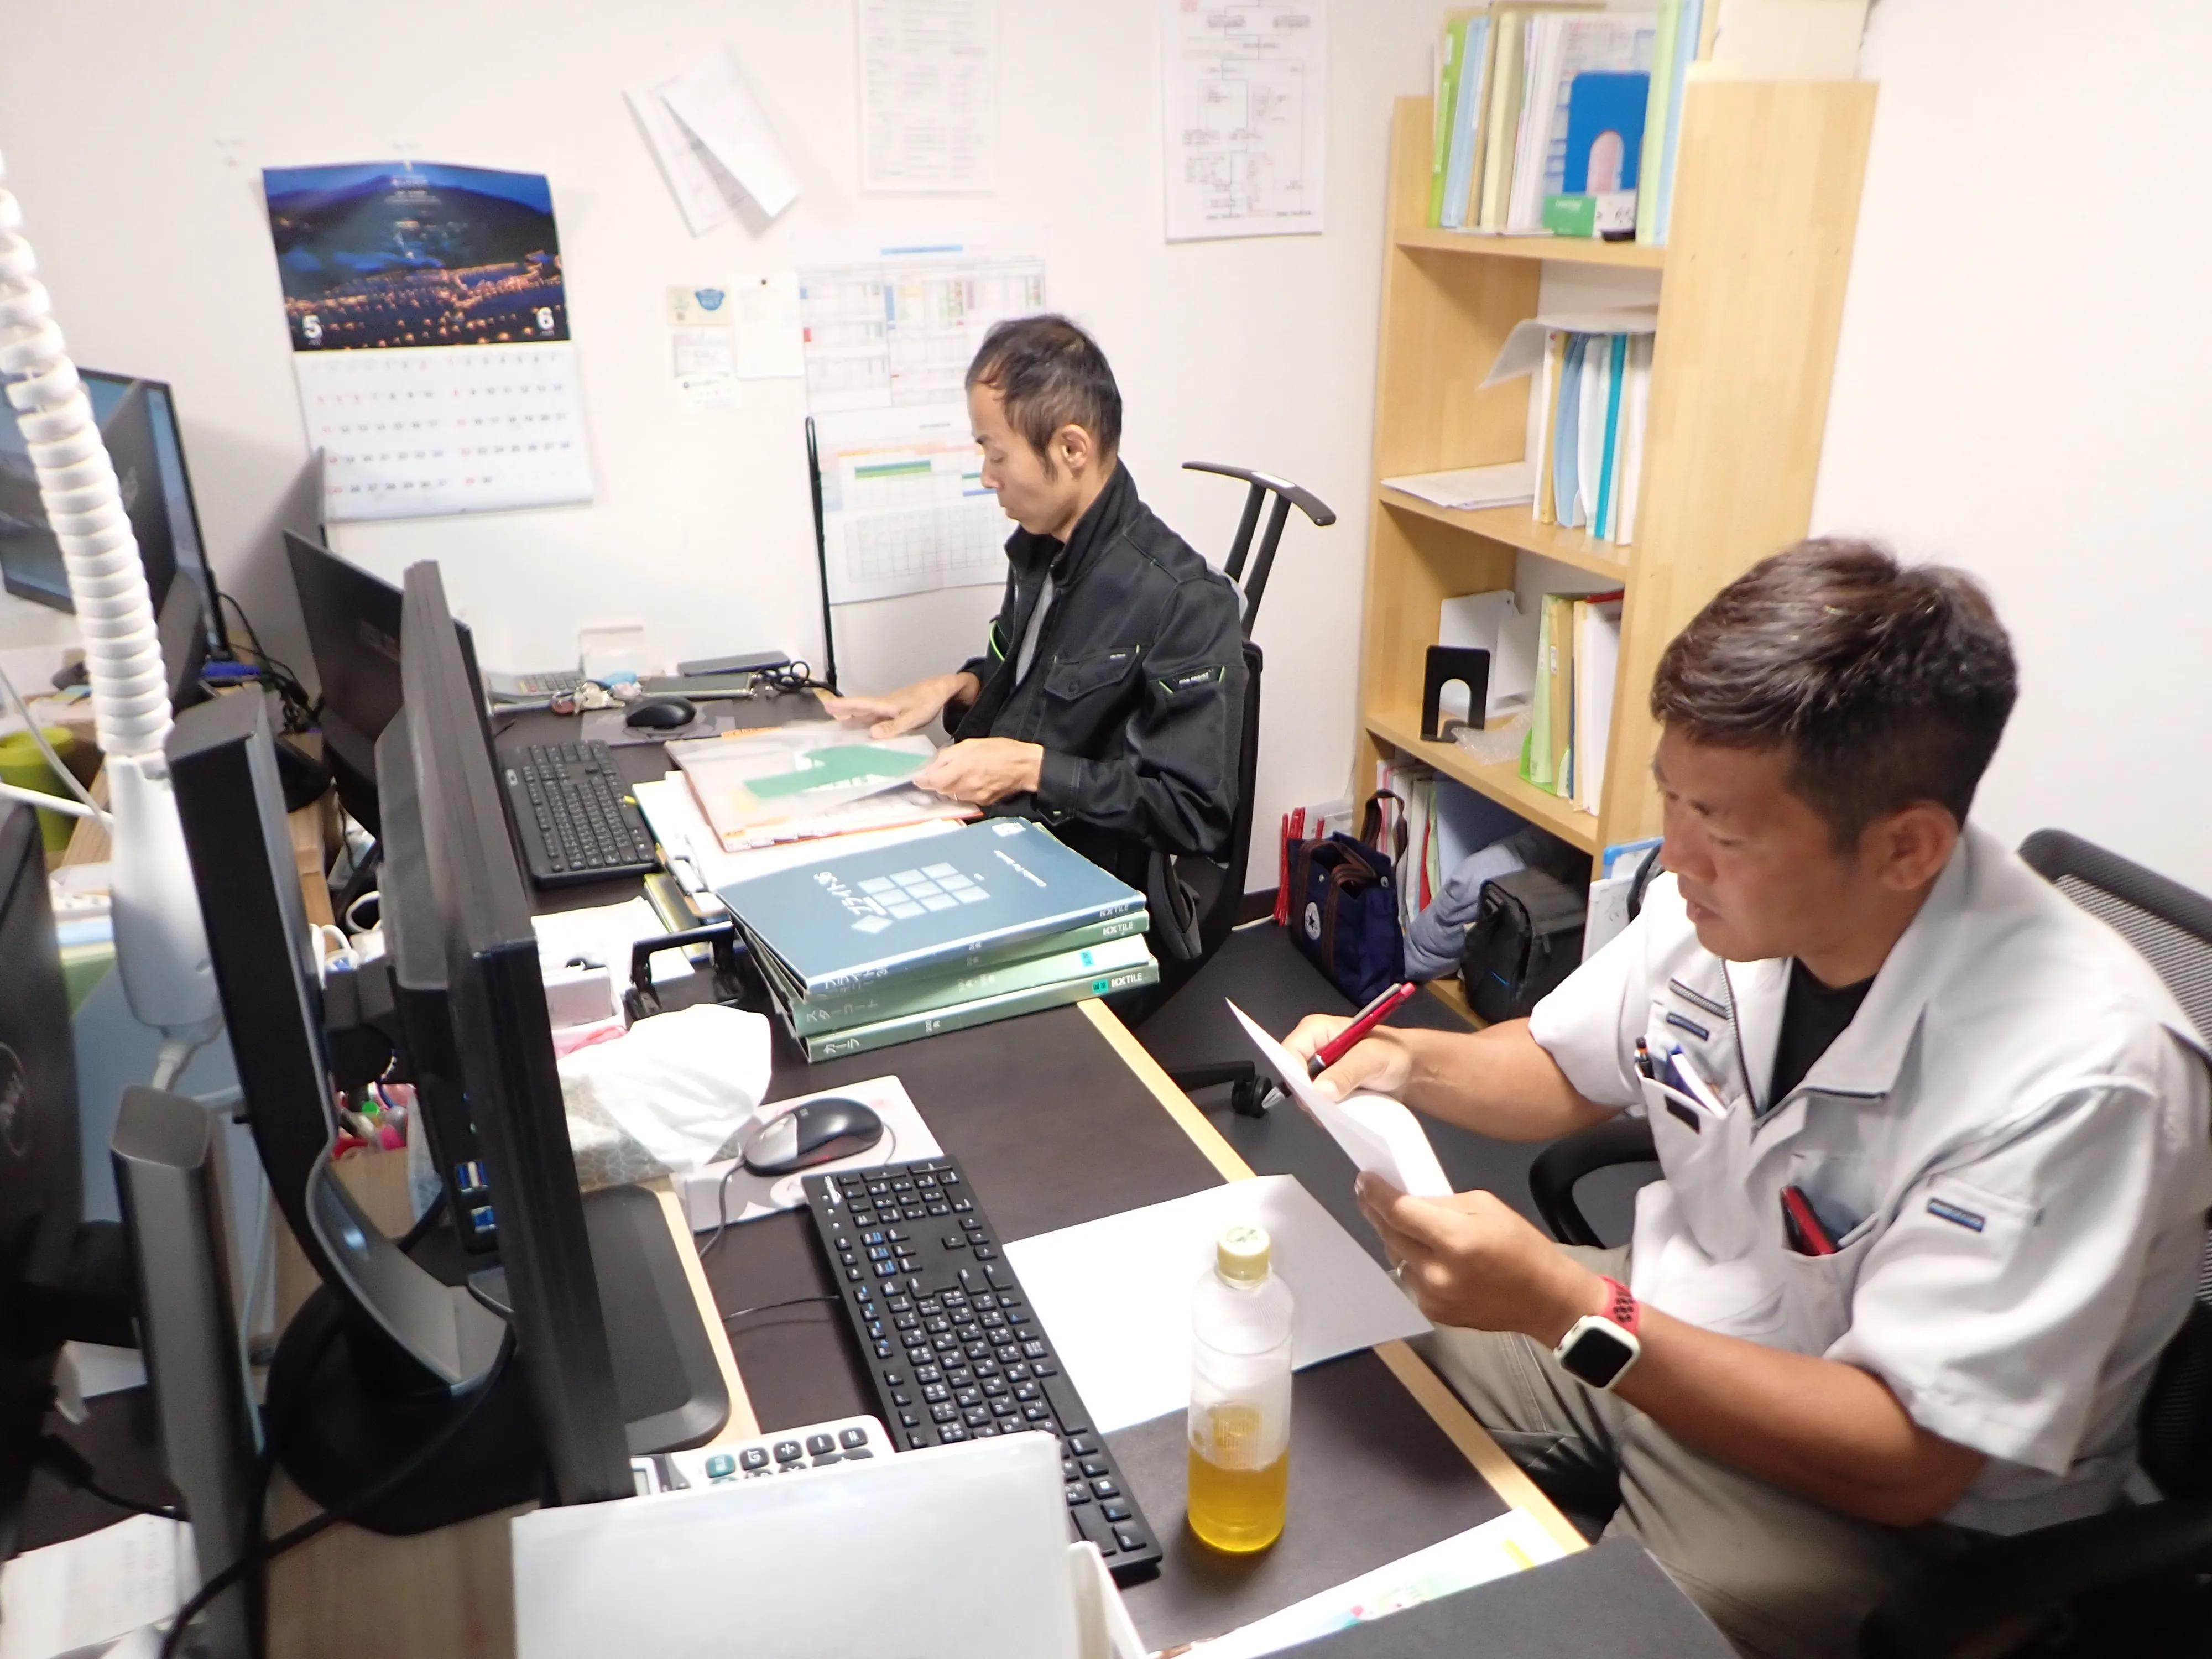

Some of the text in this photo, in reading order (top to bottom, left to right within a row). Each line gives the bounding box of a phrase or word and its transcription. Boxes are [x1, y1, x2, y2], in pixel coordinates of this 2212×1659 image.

[302, 315, 323, 338] 5
[536, 307, 554, 330] 6
[806, 999, 878, 1022] スターコート
[823, 1037, 860, 1055] カーラ
